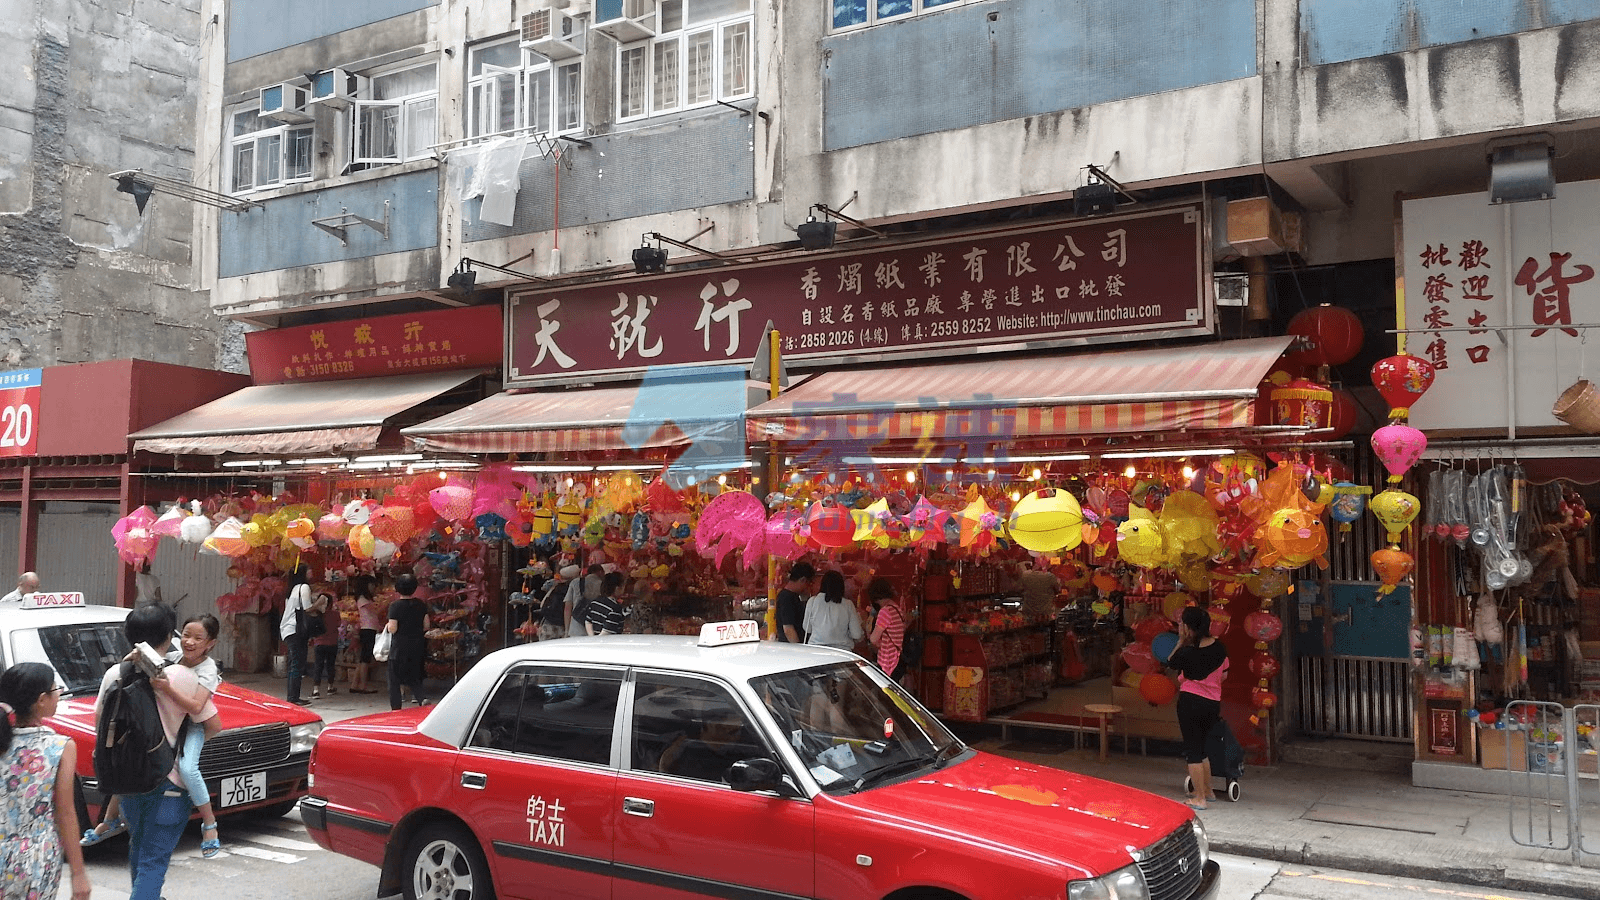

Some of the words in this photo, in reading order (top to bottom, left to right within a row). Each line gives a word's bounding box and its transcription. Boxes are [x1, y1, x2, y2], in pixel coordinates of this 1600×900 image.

[800, 229, 1128, 300] 香燭紙業有限公司
[802, 294, 945, 326] 自設名香紙品廠
[957, 274, 1126, 313] 專營進出口批發
[1420, 244, 1453, 370] 批發零售
[1458, 240, 1494, 364] 歡迎出口
[1514, 252, 1595, 338] 貨
[531, 278, 753, 369] 天就行
[801, 333, 826, 349] 2858
[828, 330, 855, 346] 2026
[931, 319, 960, 337] 2559
[962, 317, 991, 334] 8252
[997, 314, 1039, 331] Website:
[1040, 303, 1162, 330] http://www.tinchau.com
[309, 363, 331, 376] 3150
[0, 403, 33, 448] 20
[33, 593, 81, 606] TAXI
[716, 622, 757, 641] TAXI
[226, 786, 261, 806] 7012
[234, 774, 254, 792] KE
[526, 794, 566, 823] 的士
[526, 817, 566, 848] TAXI
